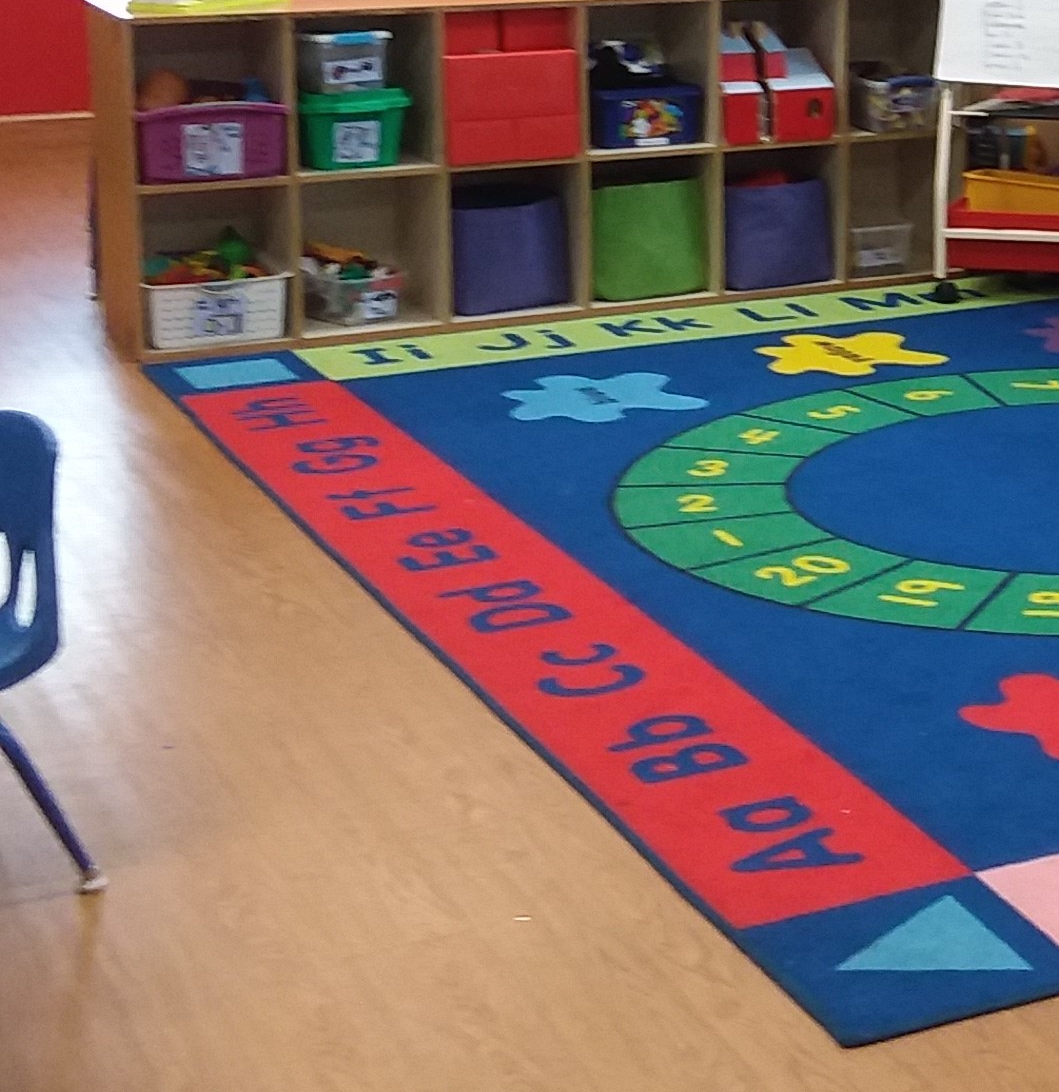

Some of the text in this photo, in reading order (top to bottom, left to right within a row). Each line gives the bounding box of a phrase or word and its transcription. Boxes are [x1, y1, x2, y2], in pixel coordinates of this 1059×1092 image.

[349, 345, 431, 366] Ii
[478, 329, 575, 351] Jj
[594, 316, 714, 339] Kk
[904, 388, 954, 402] 6
[806, 404, 861, 420] 5
[737, 427, 780, 446] 4
[687, 459, 730, 478] 3
[675, 494, 719, 513] 2
[712, 528, 744, 548] 1
[753, 554, 853, 588] 20
[878, 577, 967, 608] 19
[232, 398, 862, 871] Aa Bb Cc Dd Ee Ff Gg Hh
